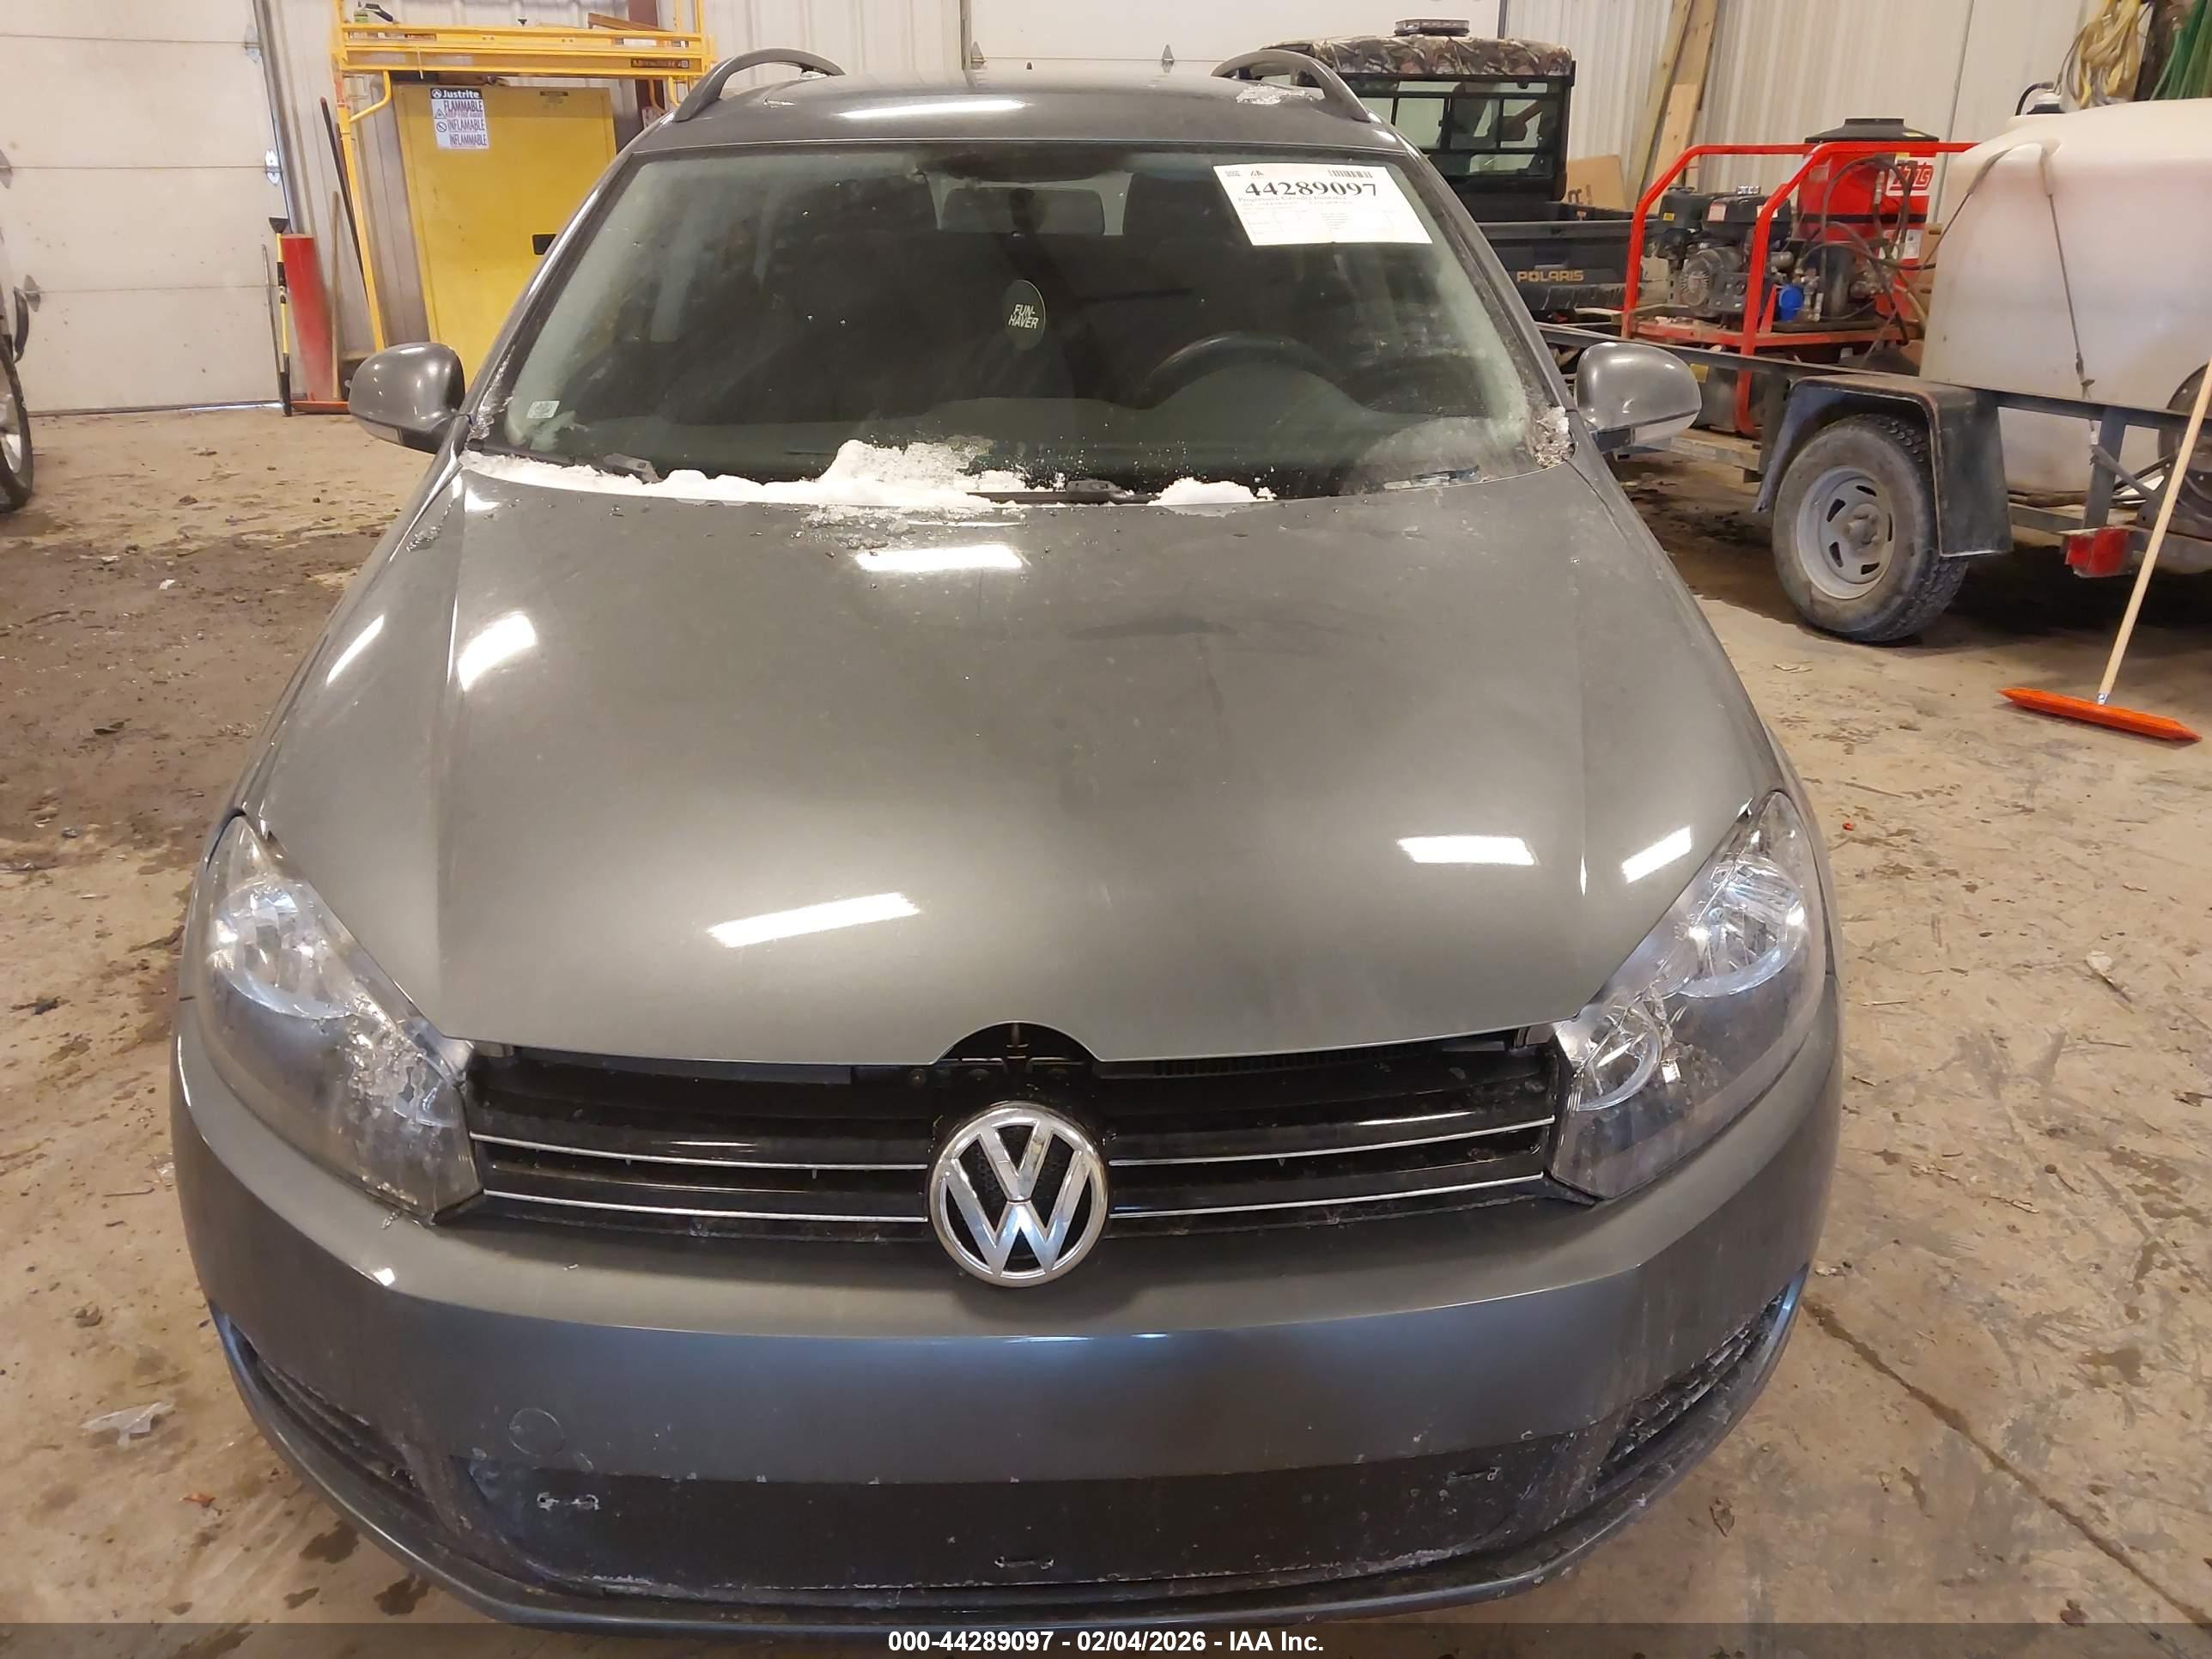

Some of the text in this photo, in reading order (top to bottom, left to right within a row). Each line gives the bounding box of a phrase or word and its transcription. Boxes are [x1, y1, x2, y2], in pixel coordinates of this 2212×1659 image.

[443, 89, 480, 98] Justrite
[444, 100, 483, 112] FLAMMABLE
[447, 119, 485, 131] INFLAMABLE
[1245, 181, 1376, 197] 44289097
[1516, 270, 1584, 283] POLARIS
[1013, 304, 1036, 317] FUN-
[1008, 314, 1039, 329] HAVER
